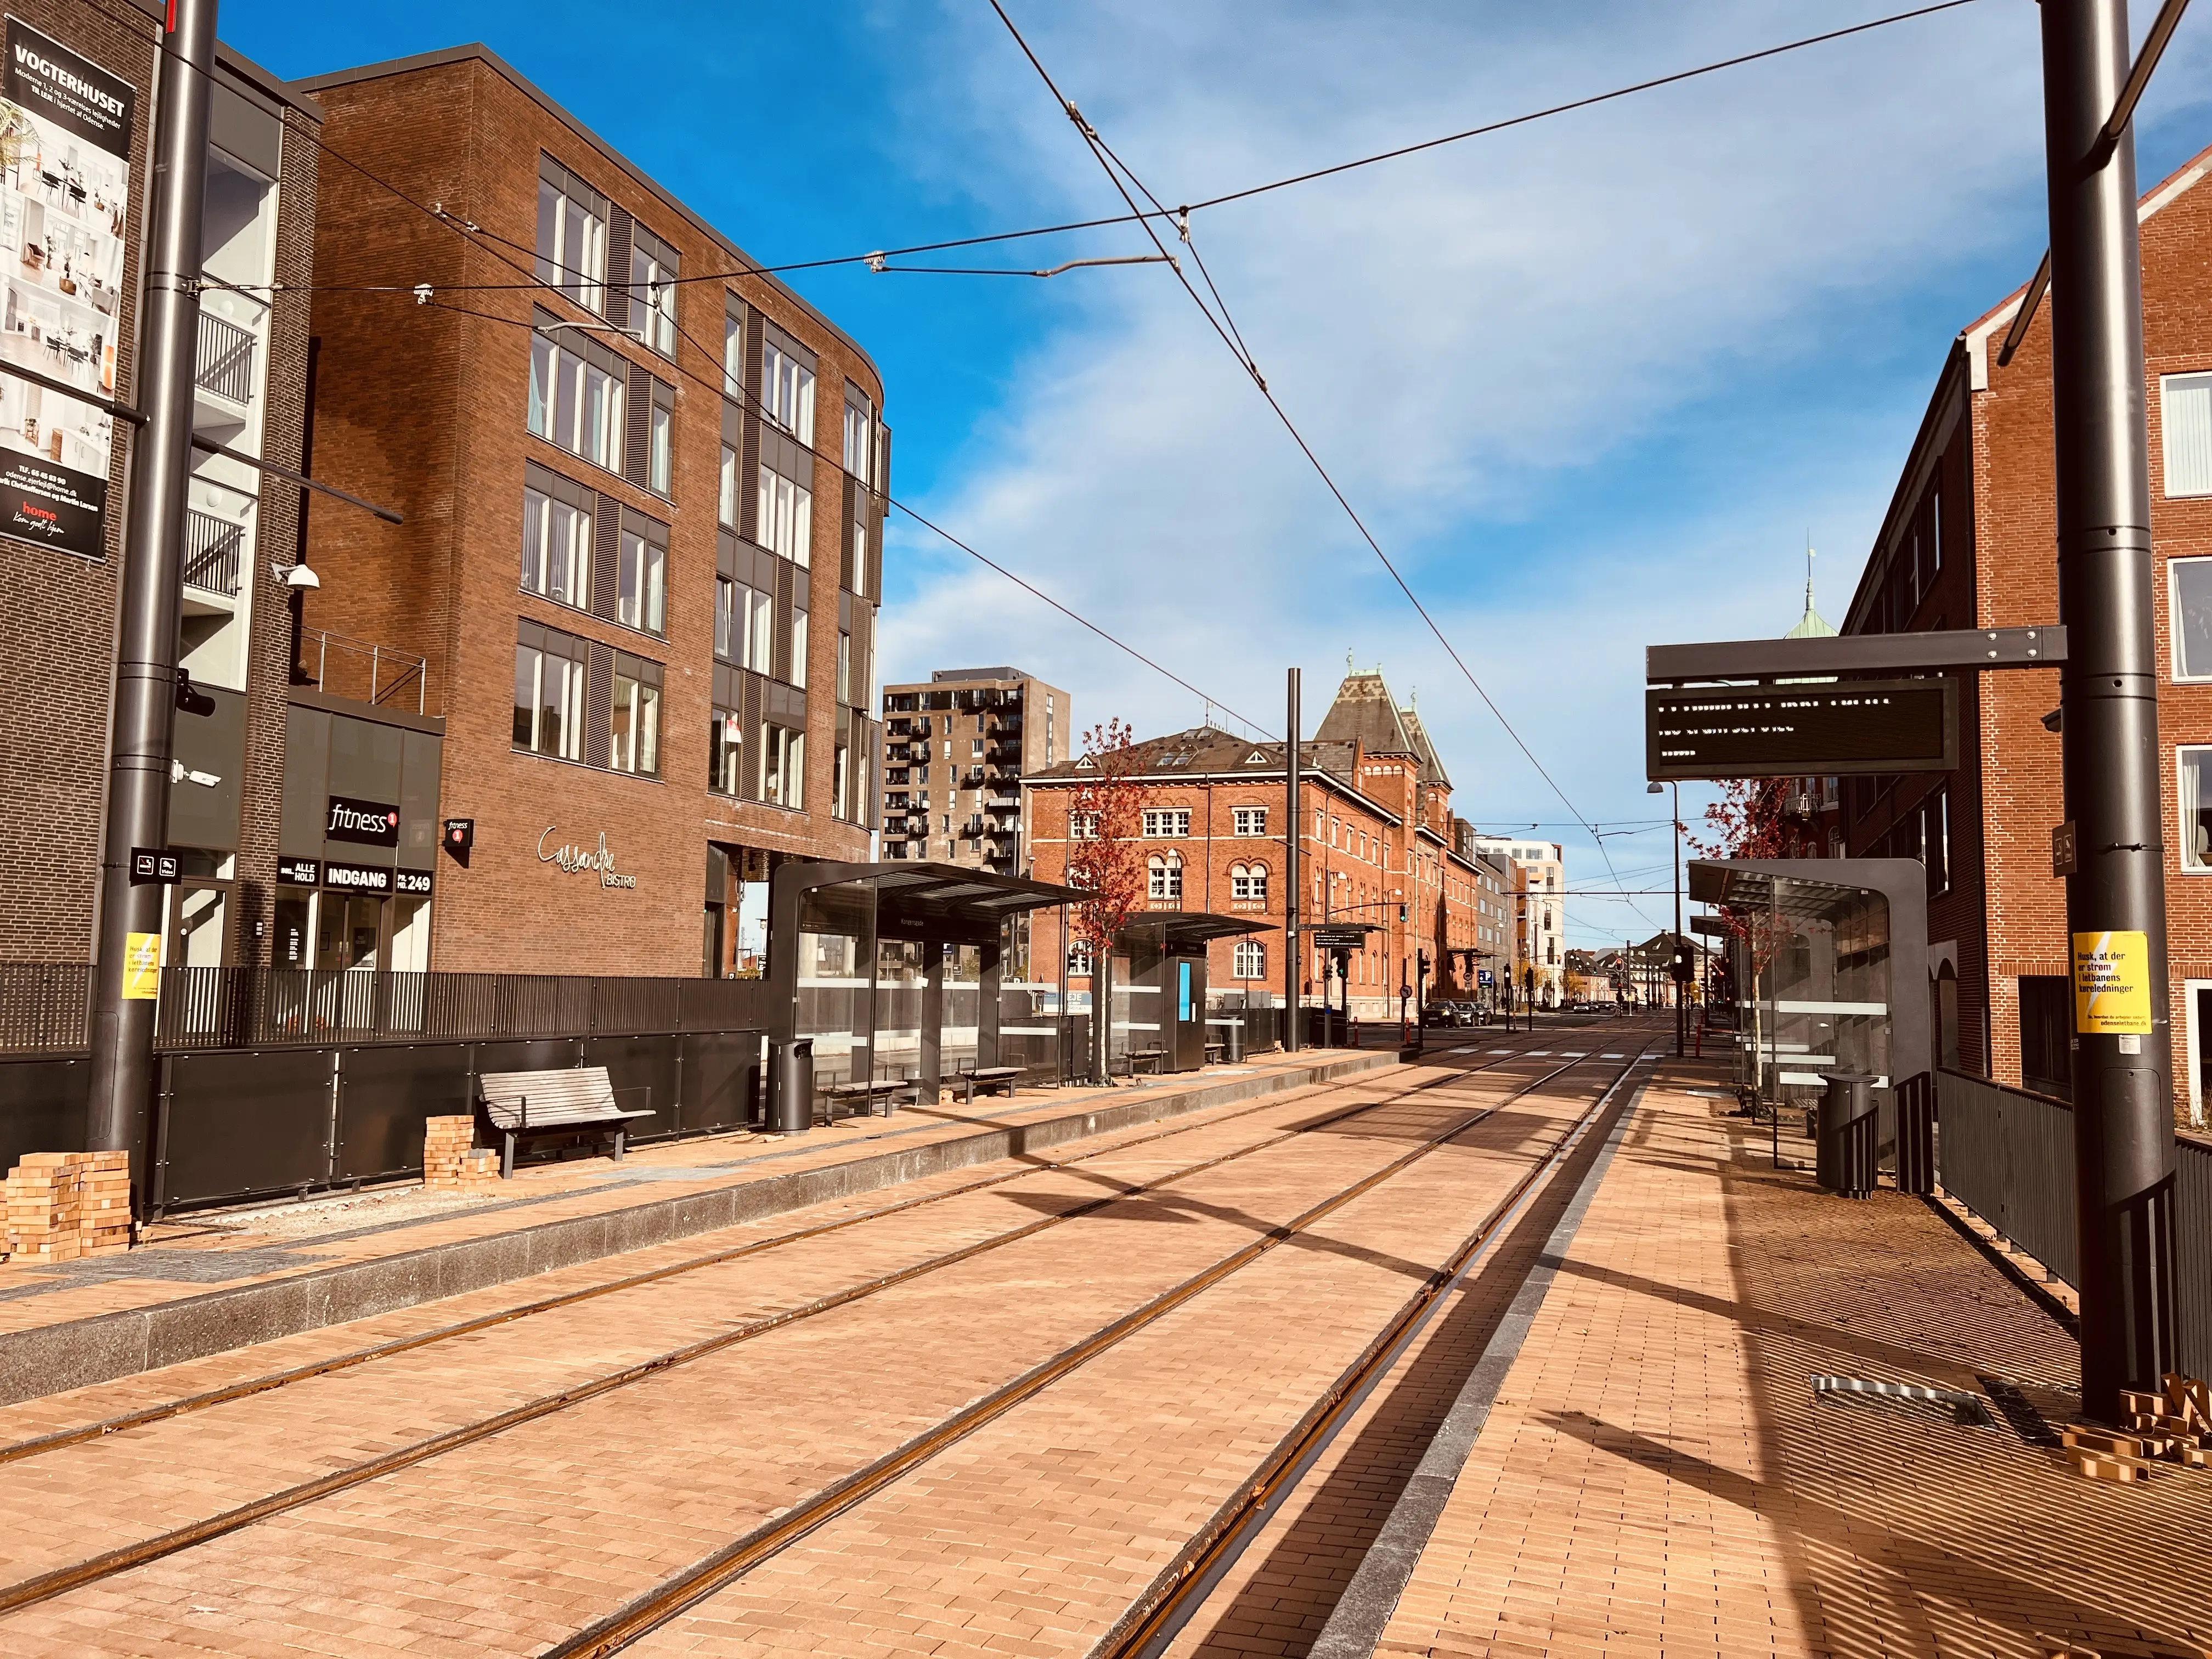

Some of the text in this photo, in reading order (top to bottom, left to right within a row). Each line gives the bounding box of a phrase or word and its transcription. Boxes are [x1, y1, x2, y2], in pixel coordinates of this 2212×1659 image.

[15, 44, 125, 117] VOGTERHUSET
[14, 67, 121, 129] Moderne 1, 2 og 3-værelses lejligheder
[31, 84, 40, 95] TIL
[41, 90, 53, 103] LEJE
[57, 99, 76, 116] hjertet
[76, 110, 82, 119] af
[82, 113, 105, 131] Odense.
[31, 469, 40, 477] 65
[57, 477, 66, 485] 90
[51, 493, 60, 501] og
[80, 501, 98, 512] Larsen
[22, 501, 57, 521] home
[13, 511, 65, 537] Kom godt hjem
[329, 804, 387, 833] fitness
[448, 821, 468, 830] fitness
[295, 863, 315, 873] ALLE
[295, 872, 315, 883] HOLD
[329, 868, 387, 888] INDGANG
[397, 873, 407, 882] PR.
[397, 875, 431, 891] MD. 249
[606, 874, 636, 888] BISTRO
[2077, 952, 2126, 962] Husk, at der
[2079, 984, 2134, 994] køreledninger
